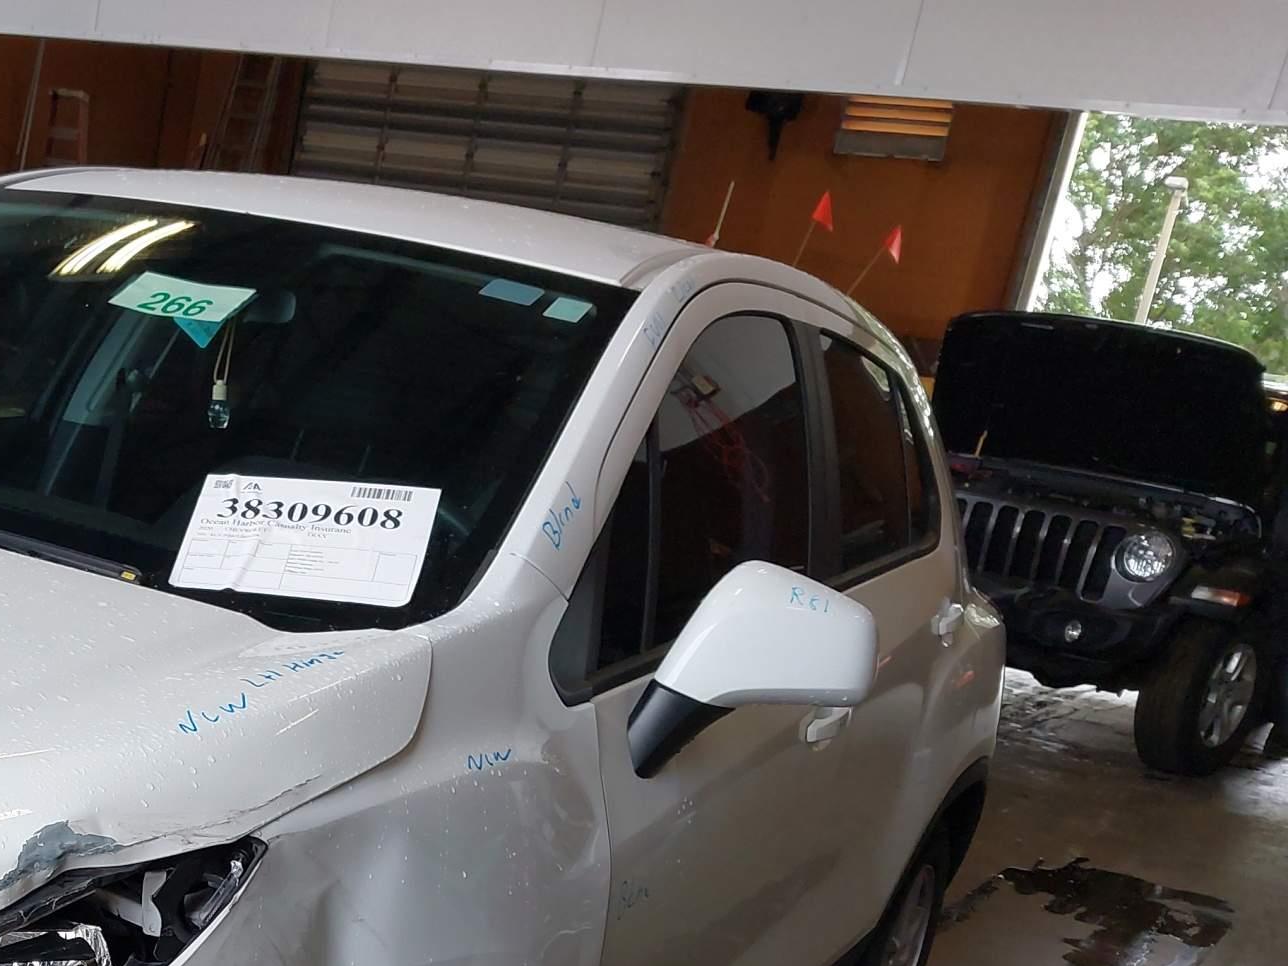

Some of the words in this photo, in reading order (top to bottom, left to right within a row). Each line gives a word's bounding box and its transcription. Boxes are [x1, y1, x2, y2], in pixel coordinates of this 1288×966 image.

[137, 292, 213, 316] 266
[217, 498, 403, 530] 38309608
[232, 518, 265, 527] Harbor
